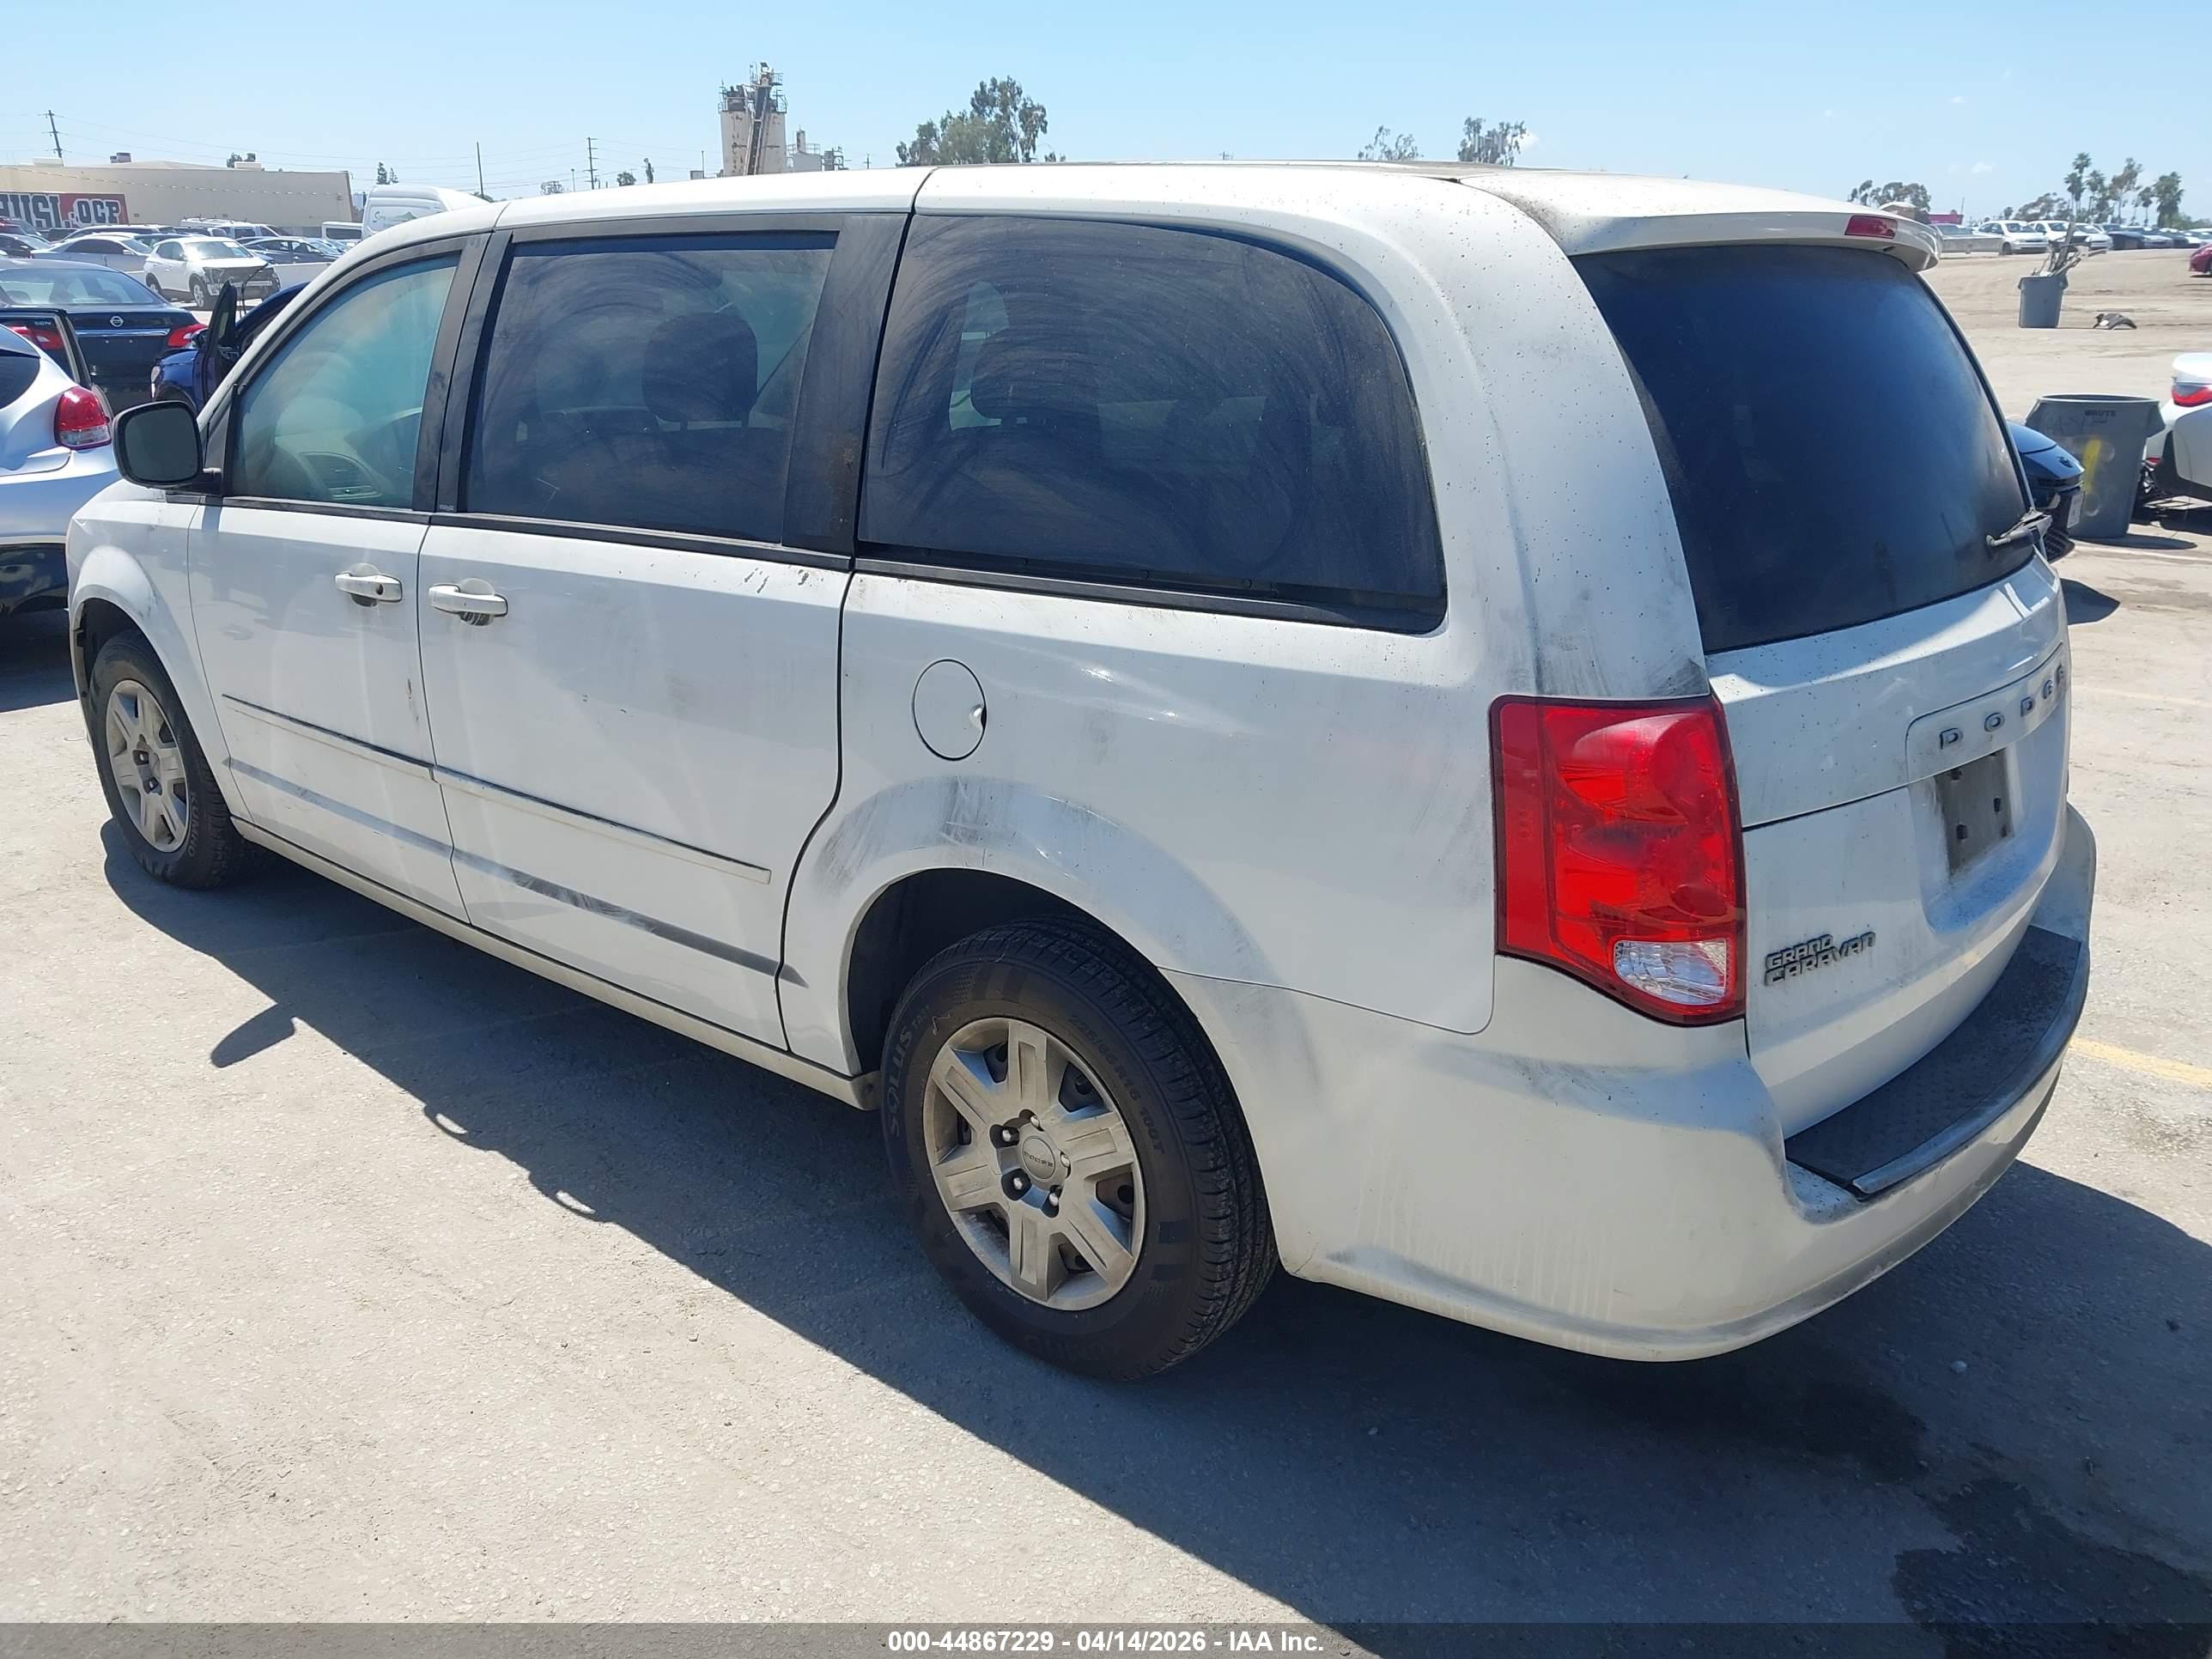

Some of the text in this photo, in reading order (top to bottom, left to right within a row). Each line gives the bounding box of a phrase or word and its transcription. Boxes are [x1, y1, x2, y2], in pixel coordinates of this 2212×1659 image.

[1939, 664, 2069, 750] DODGE
[1764, 931, 1876, 987] CARAVAN
[1765, 933, 1834, 970] GRAND
[886, 1025, 914, 1138] SOLUS
